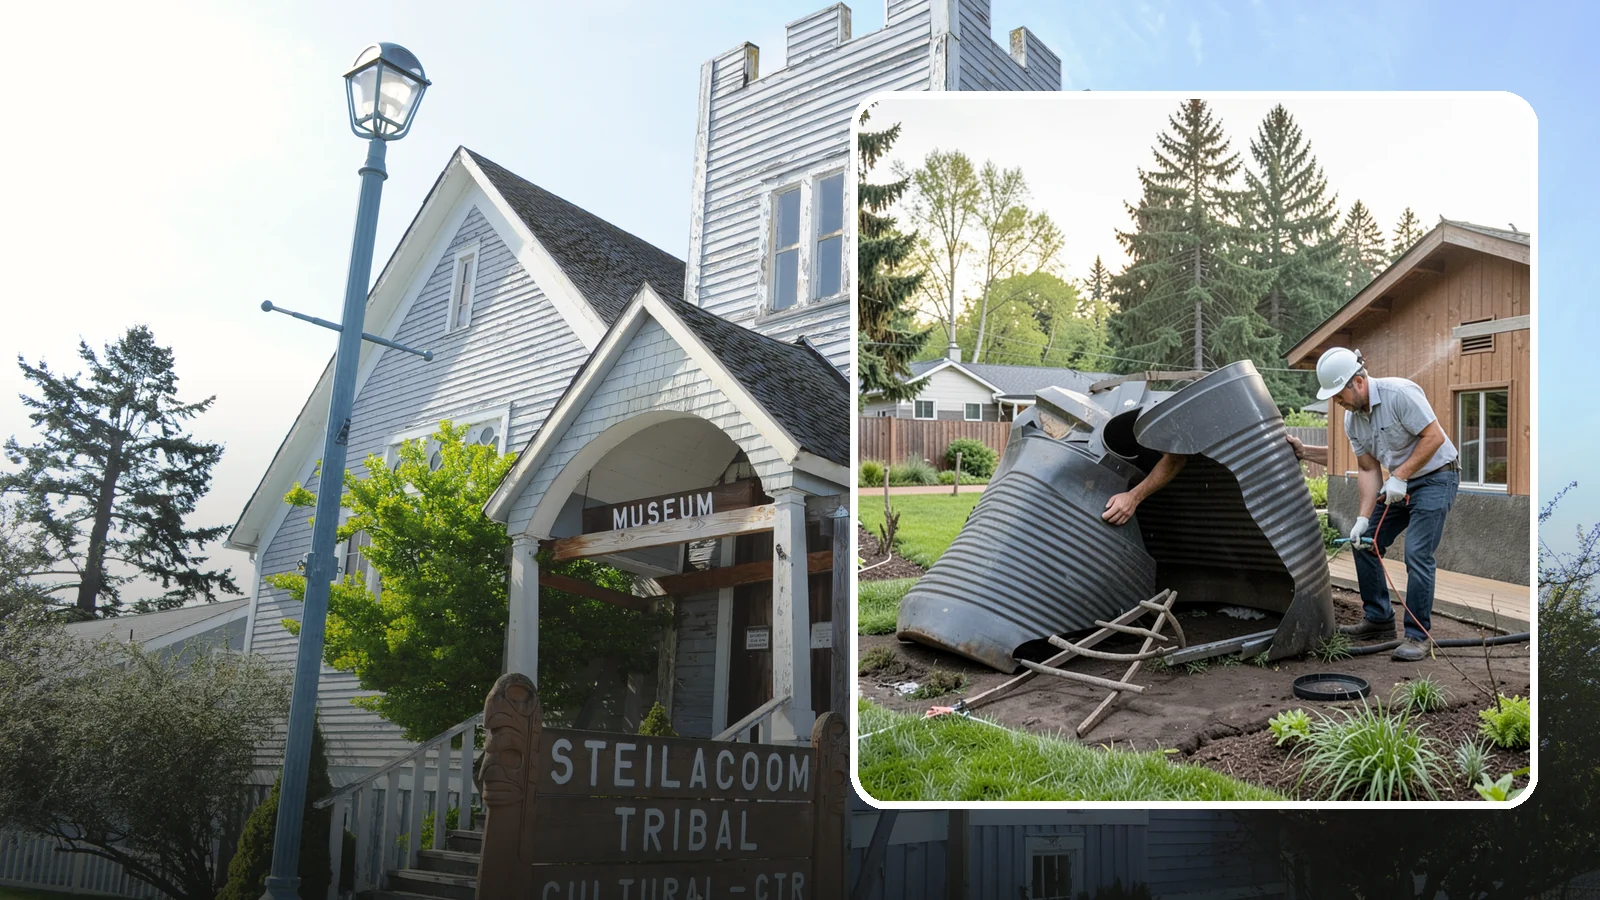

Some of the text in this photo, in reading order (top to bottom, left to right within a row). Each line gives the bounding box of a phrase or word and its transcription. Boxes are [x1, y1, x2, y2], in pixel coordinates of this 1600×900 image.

[613, 491, 713, 531] MUSEUM
[551, 739, 809, 792] STEILACOOM
[615, 807, 757, 851] TRIBAL
